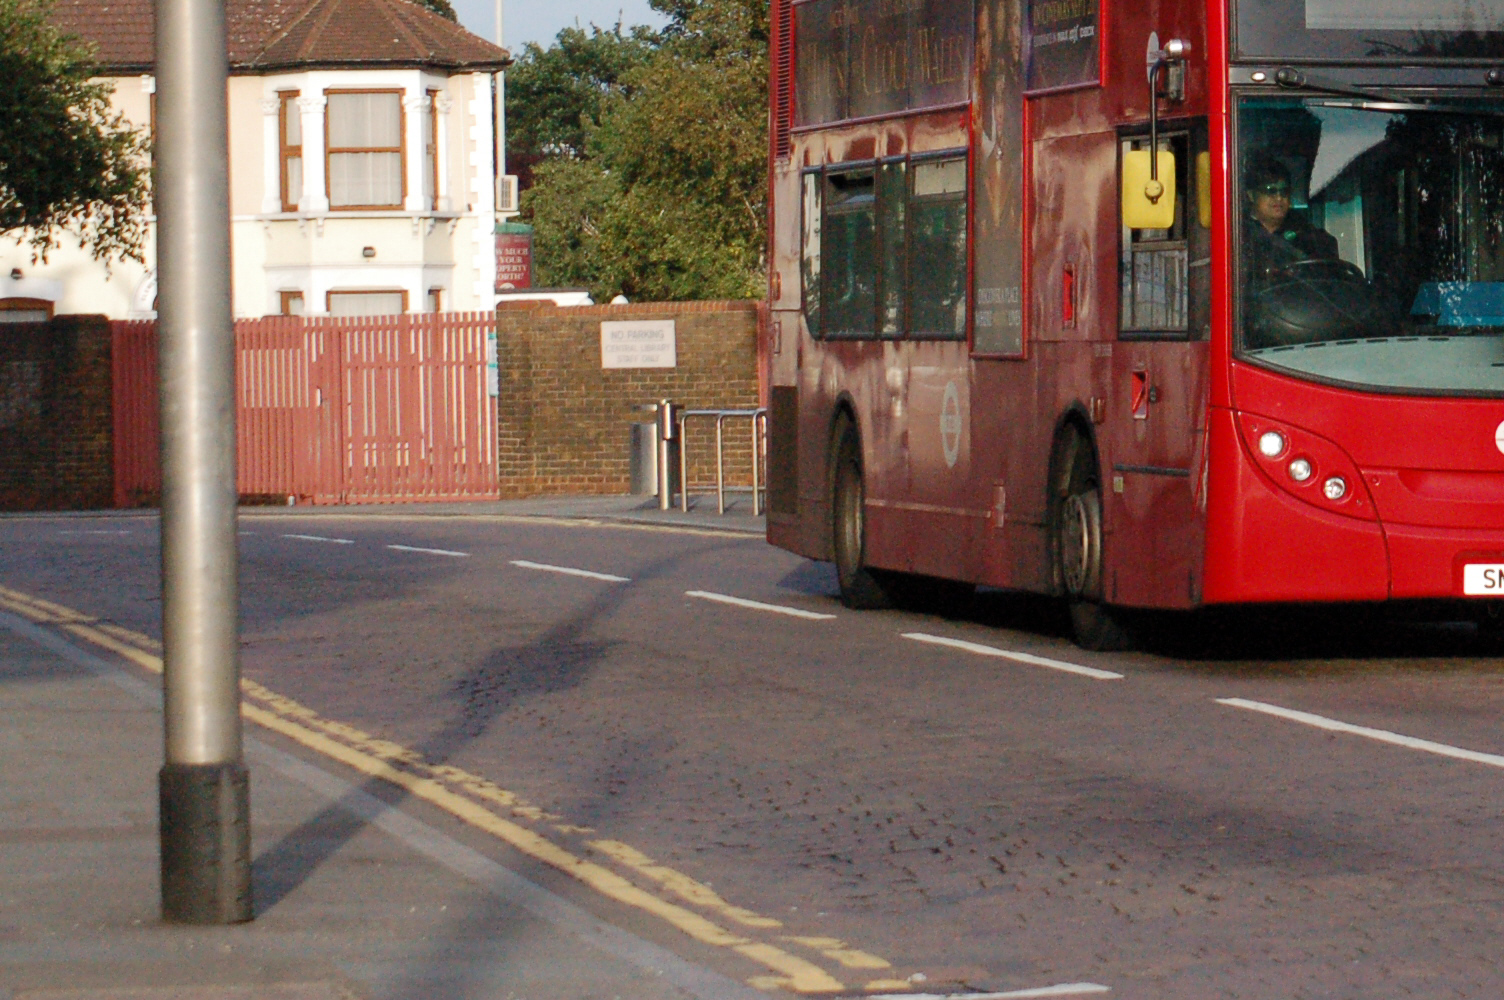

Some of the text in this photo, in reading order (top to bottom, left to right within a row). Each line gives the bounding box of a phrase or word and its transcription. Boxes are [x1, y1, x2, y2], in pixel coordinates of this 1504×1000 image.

[499, 256, 523, 264] YOUR
[611, 328, 665, 341] NO PARKING
